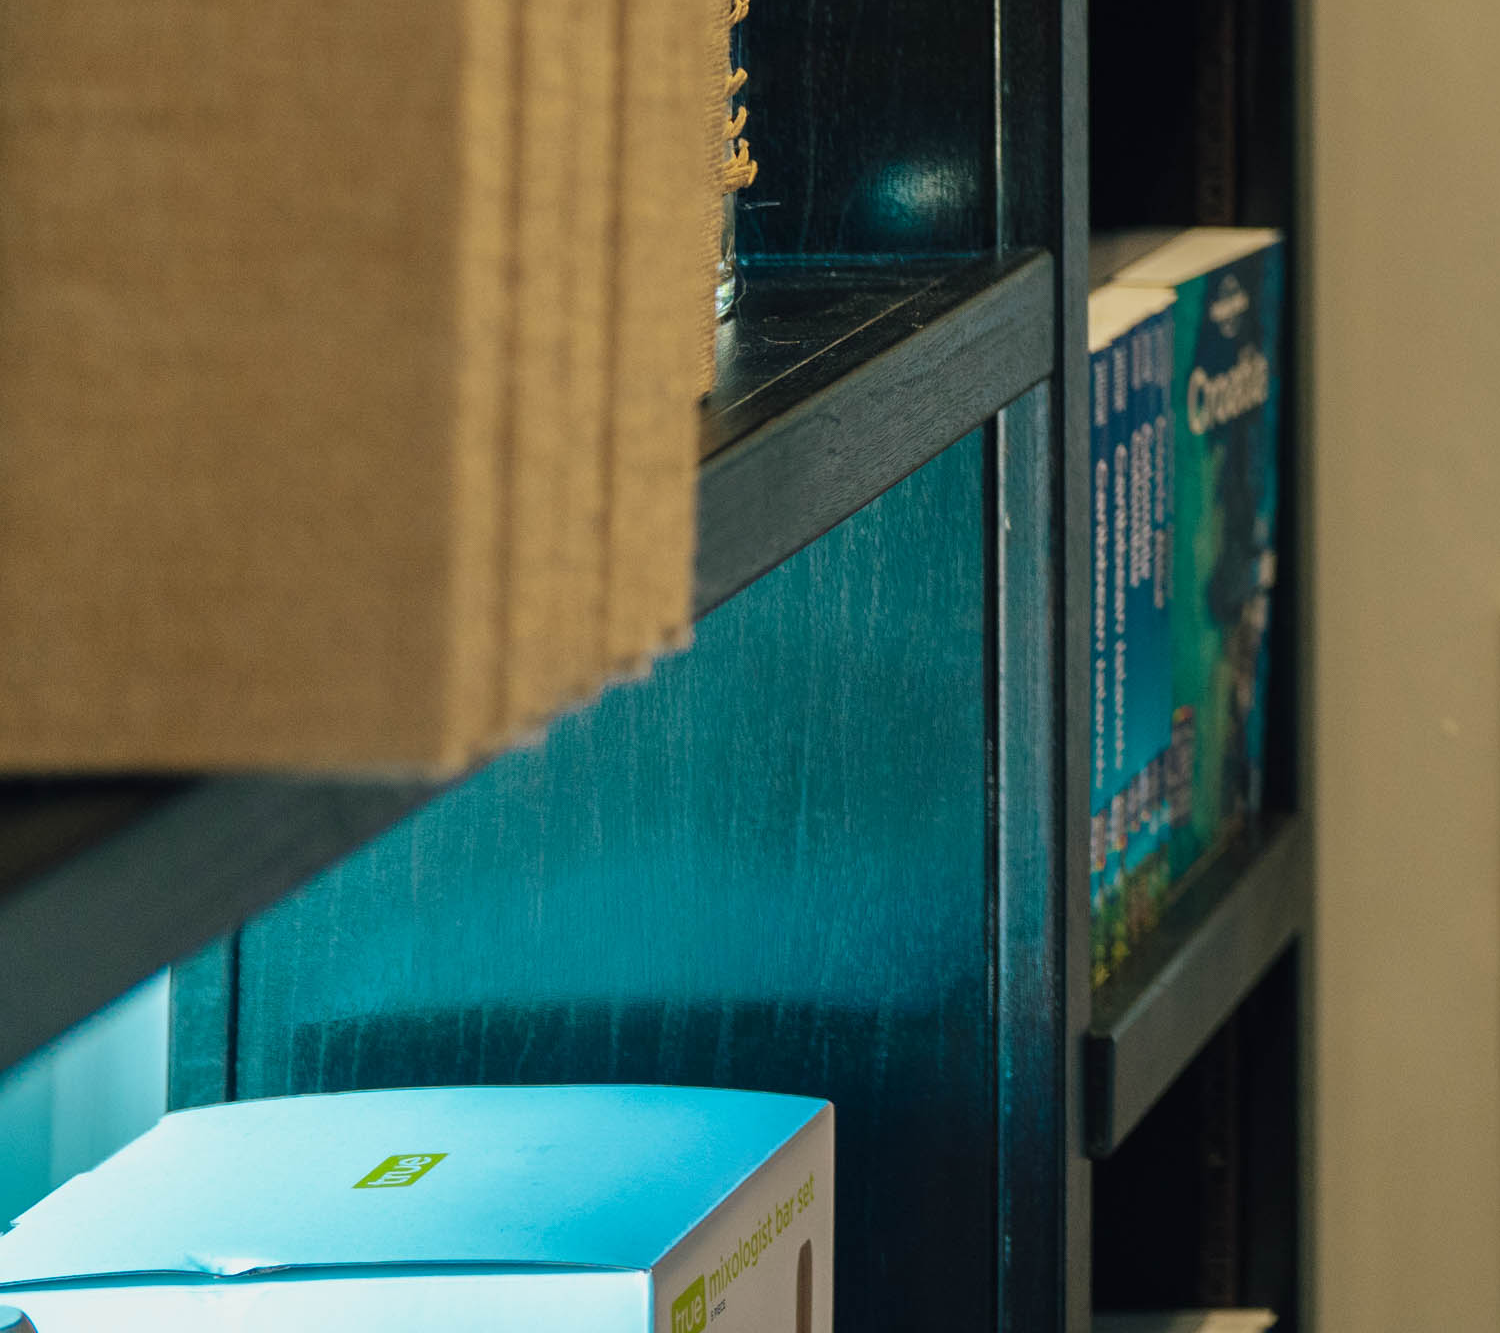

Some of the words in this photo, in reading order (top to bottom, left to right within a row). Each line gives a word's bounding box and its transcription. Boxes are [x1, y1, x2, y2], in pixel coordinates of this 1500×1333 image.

[367, 1155, 432, 1186] true
[709, 1212, 773, 1302] mixologist
[775, 1196, 794, 1235] bar
[797, 1172, 815, 1214] set
